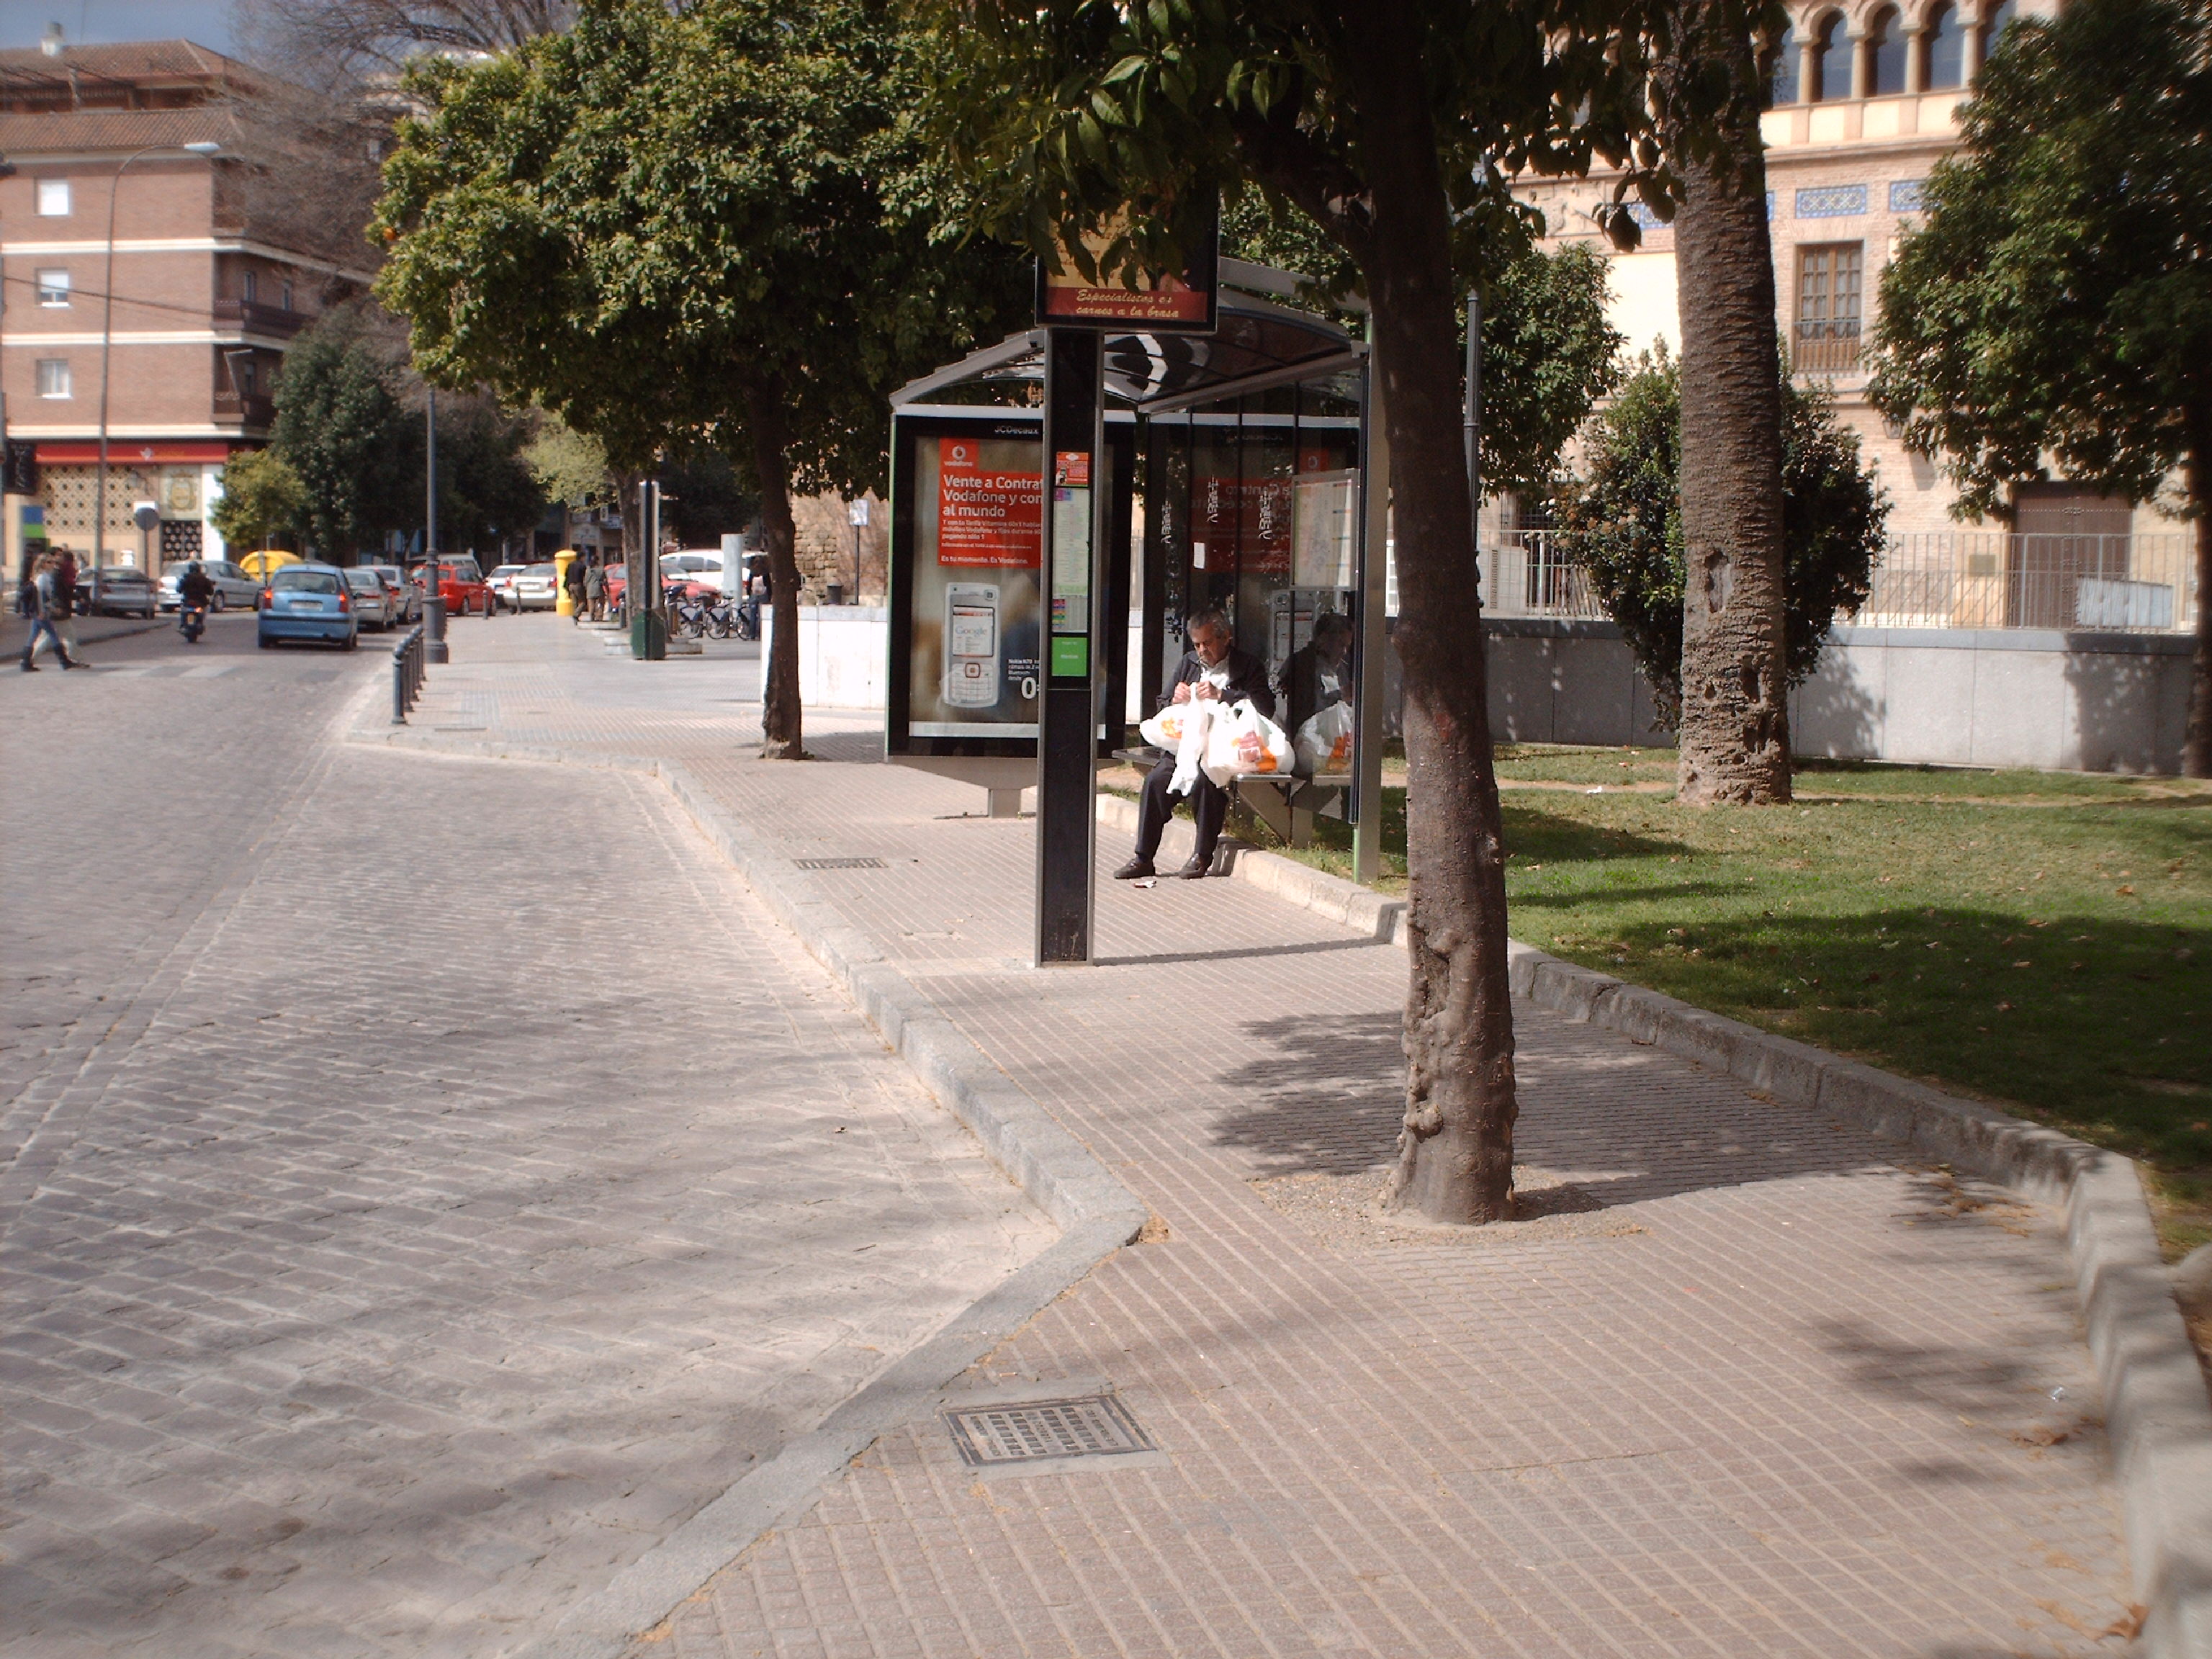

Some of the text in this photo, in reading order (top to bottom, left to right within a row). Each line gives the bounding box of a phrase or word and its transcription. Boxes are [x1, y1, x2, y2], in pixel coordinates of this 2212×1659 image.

[943, 474, 983, 488] Vente
[984, 477, 994, 489] a
[943, 489, 1007, 503] Vodafone
[1009, 494, 1017, 505] y
[942, 504, 1006, 518] al mundo
